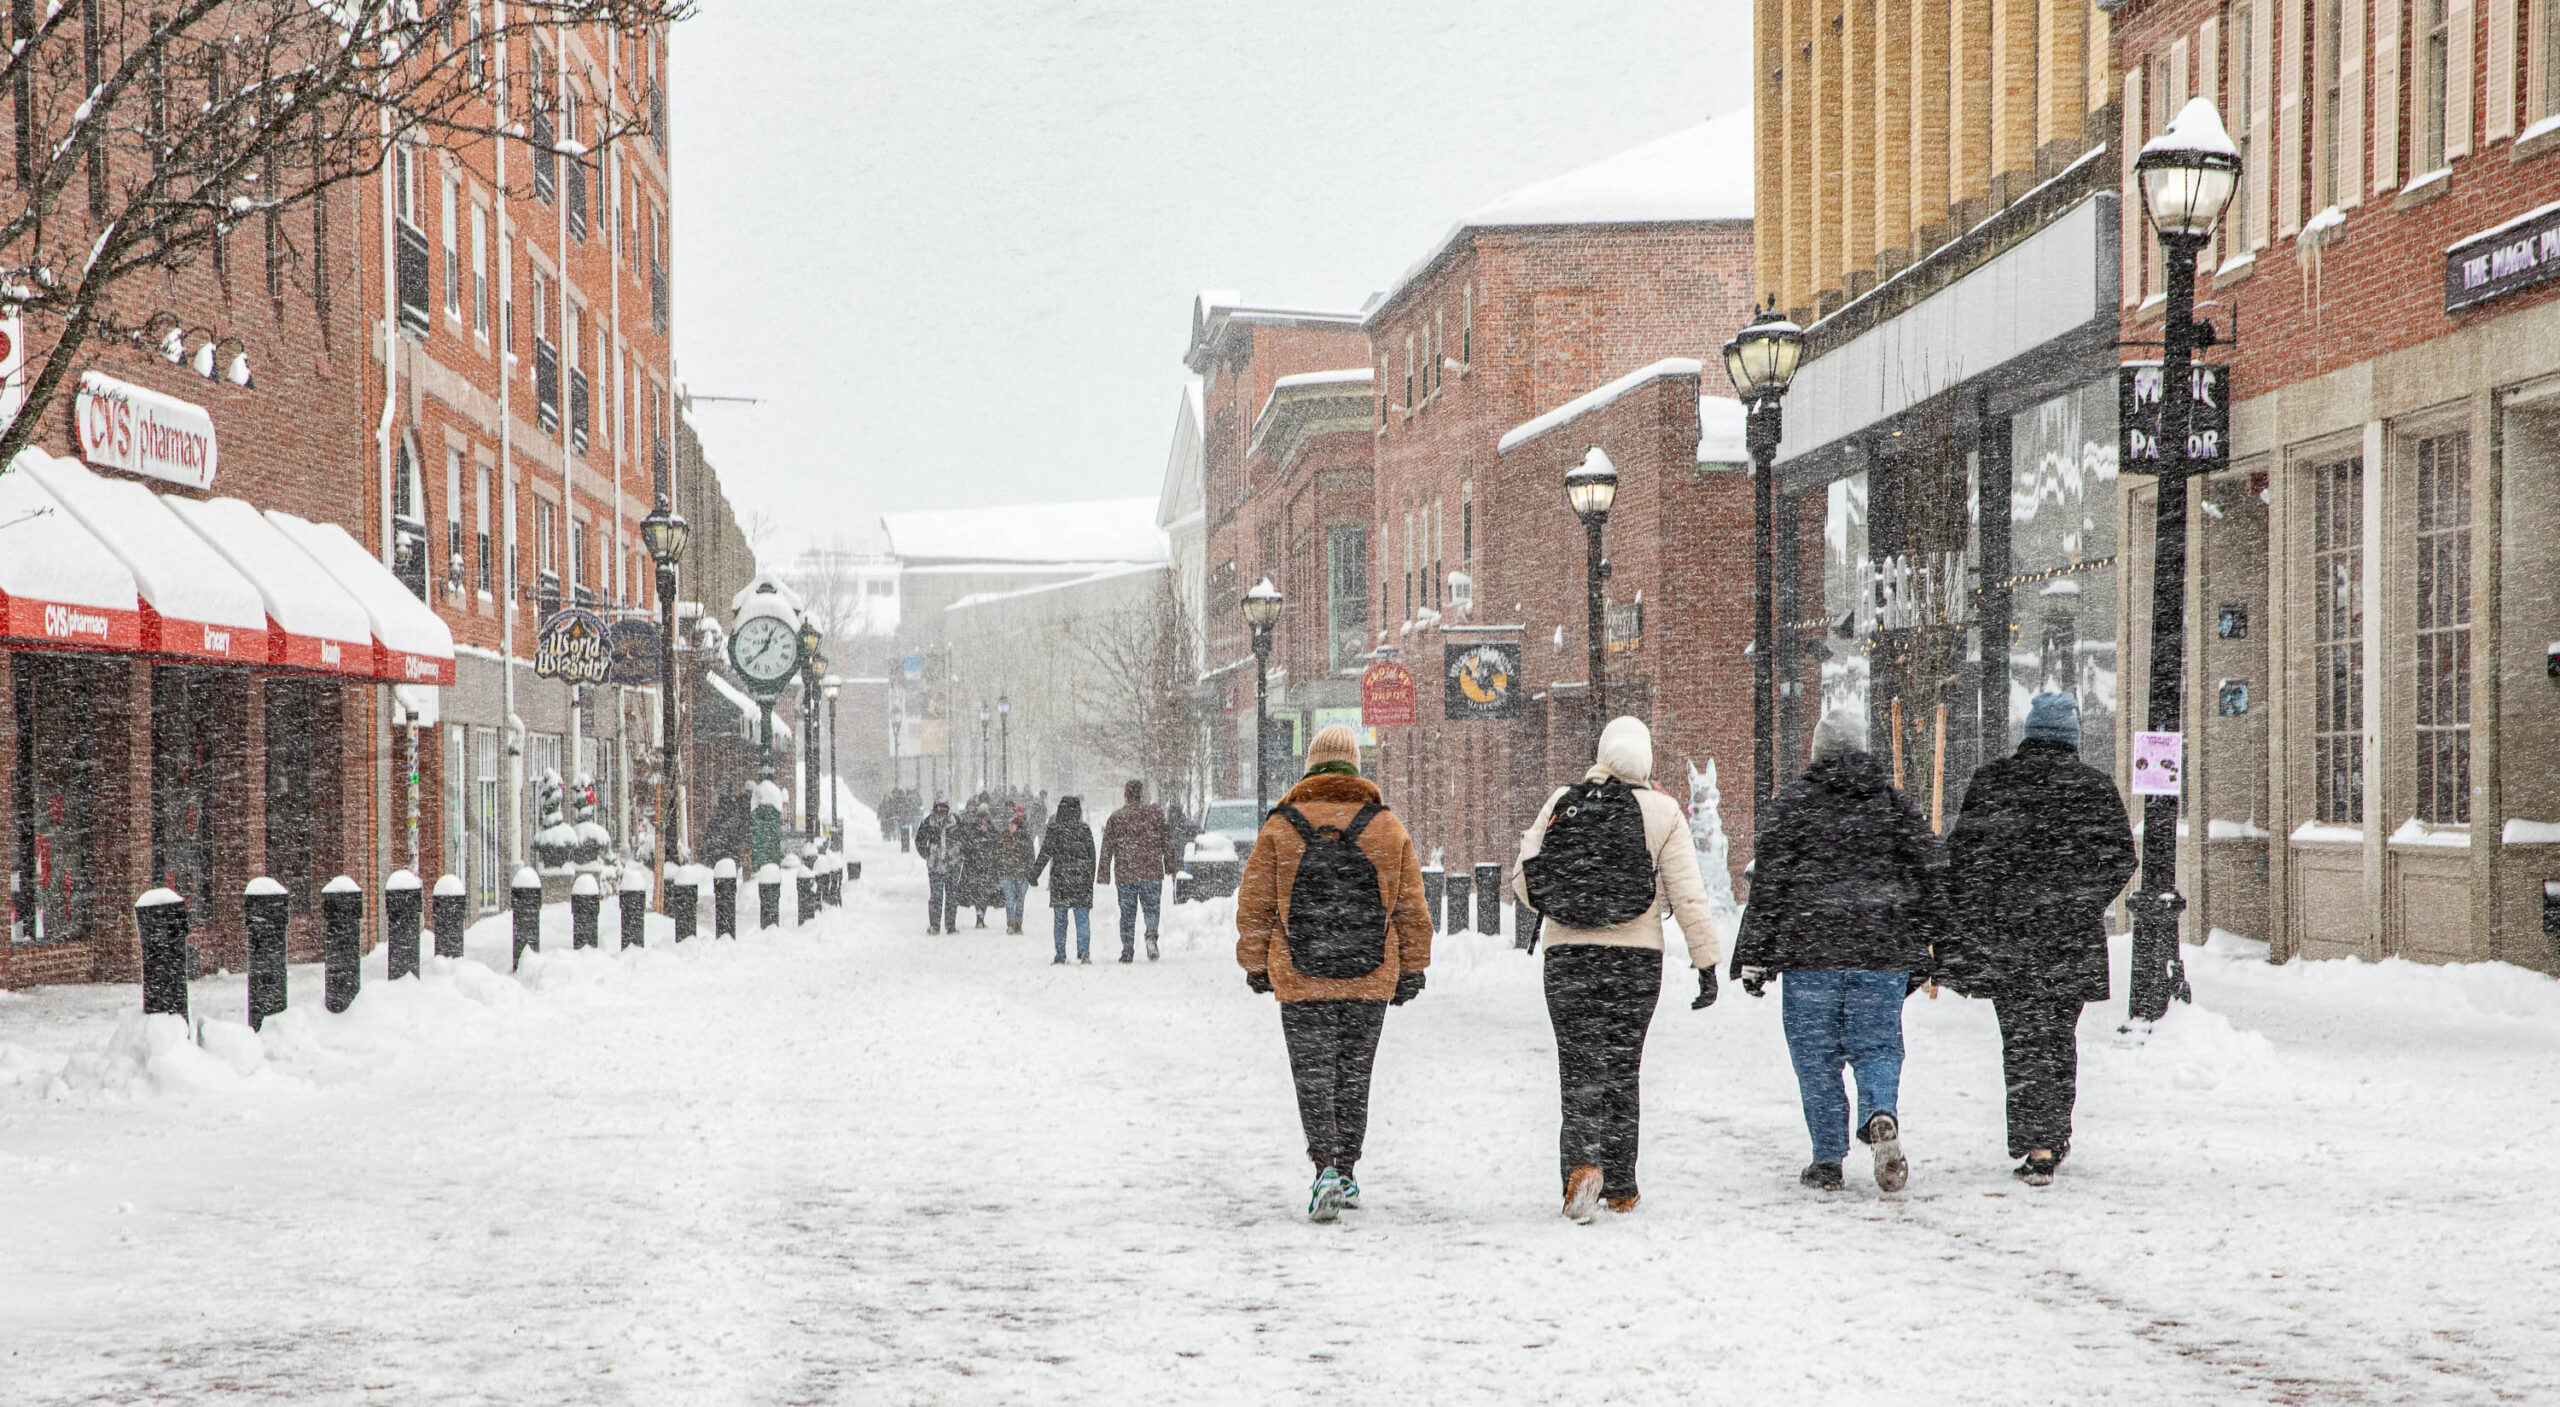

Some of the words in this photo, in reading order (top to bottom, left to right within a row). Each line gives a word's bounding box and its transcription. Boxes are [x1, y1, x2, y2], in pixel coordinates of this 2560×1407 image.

[2462, 254, 2490, 290] THE
[2492, 235, 2539, 280] MAGIC
[2541, 226, 2560, 263] PA
[2134, 366, 2217, 414] MIC
[2130, 429, 2218, 459] PAOR
[549, 630, 601, 660] World
[538, 652, 609, 680] Wizardry
